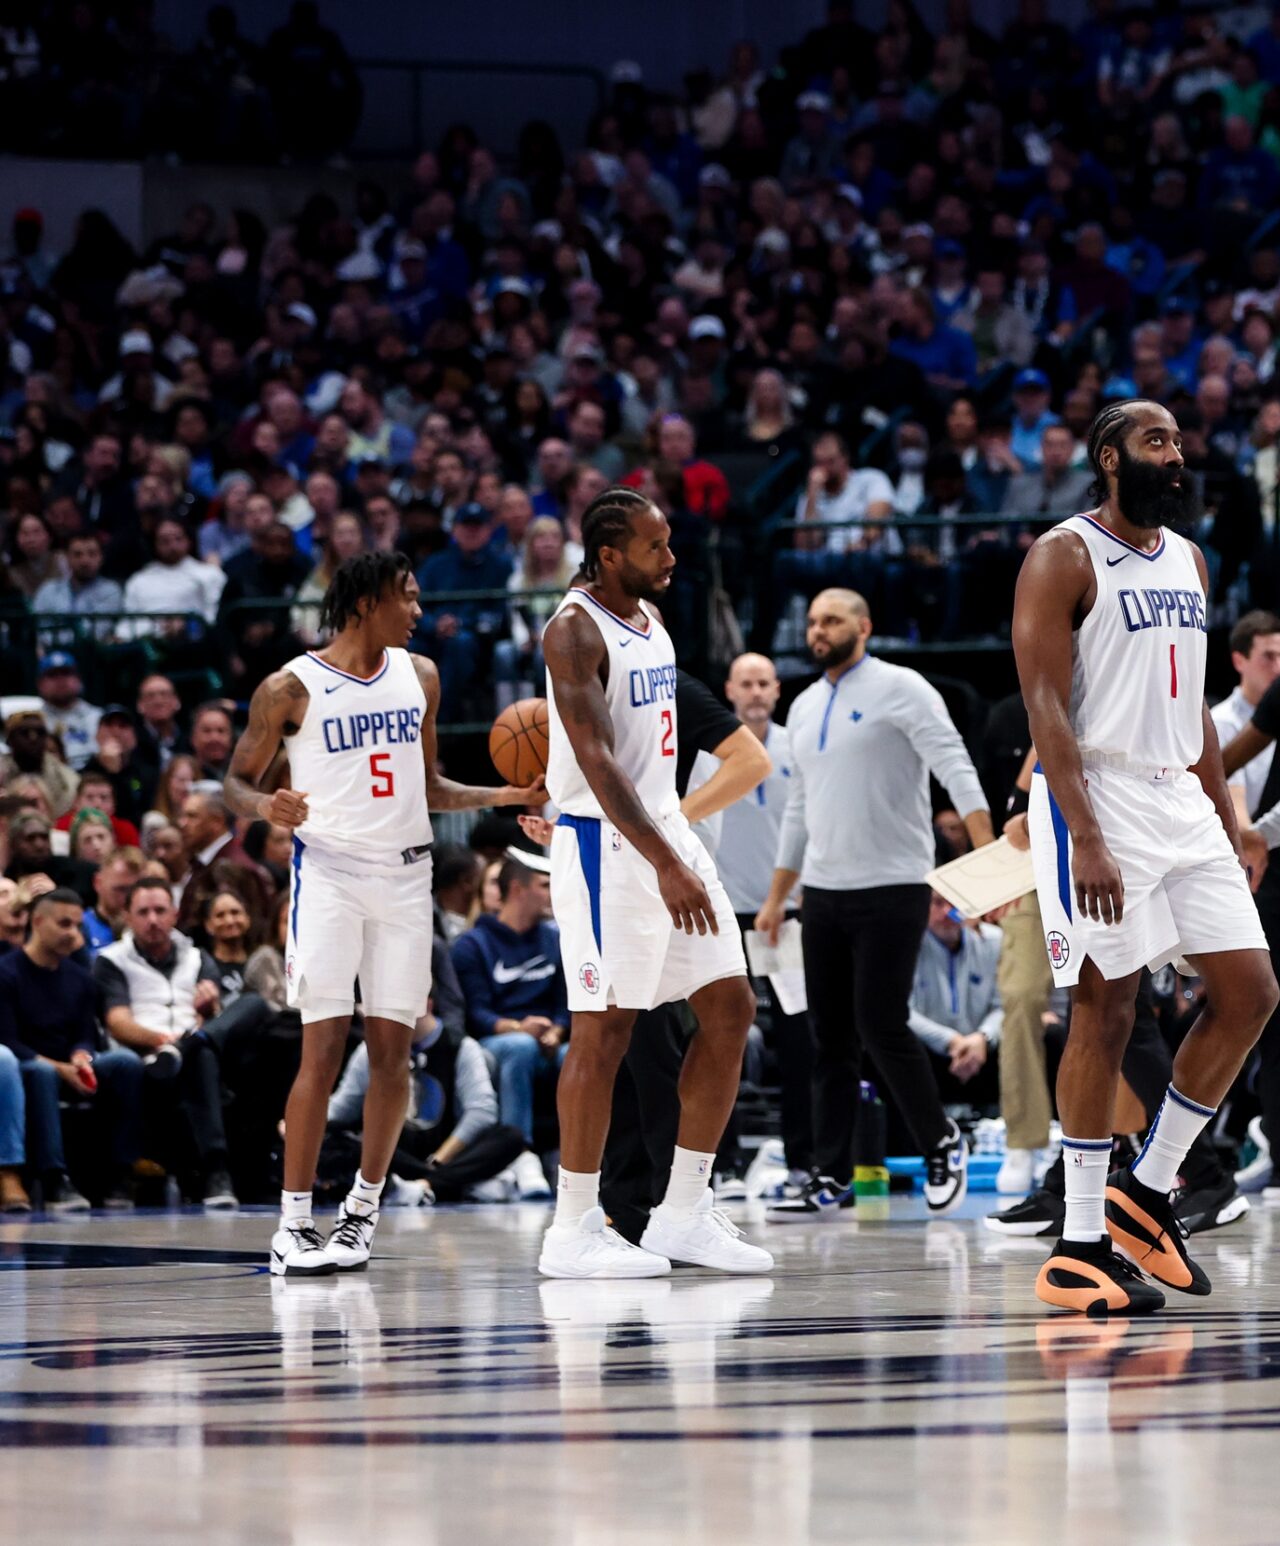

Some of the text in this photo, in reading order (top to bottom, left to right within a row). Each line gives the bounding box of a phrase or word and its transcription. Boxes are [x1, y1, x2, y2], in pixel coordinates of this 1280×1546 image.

[1118, 589, 1208, 633] CLIPPERS
[629, 664, 677, 708] CLIPPER
[1169, 644, 1177, 698] 1
[322, 707, 420, 753] CLIPPERS
[661, 710, 675, 757] 2
[370, 753, 394, 798] 5
